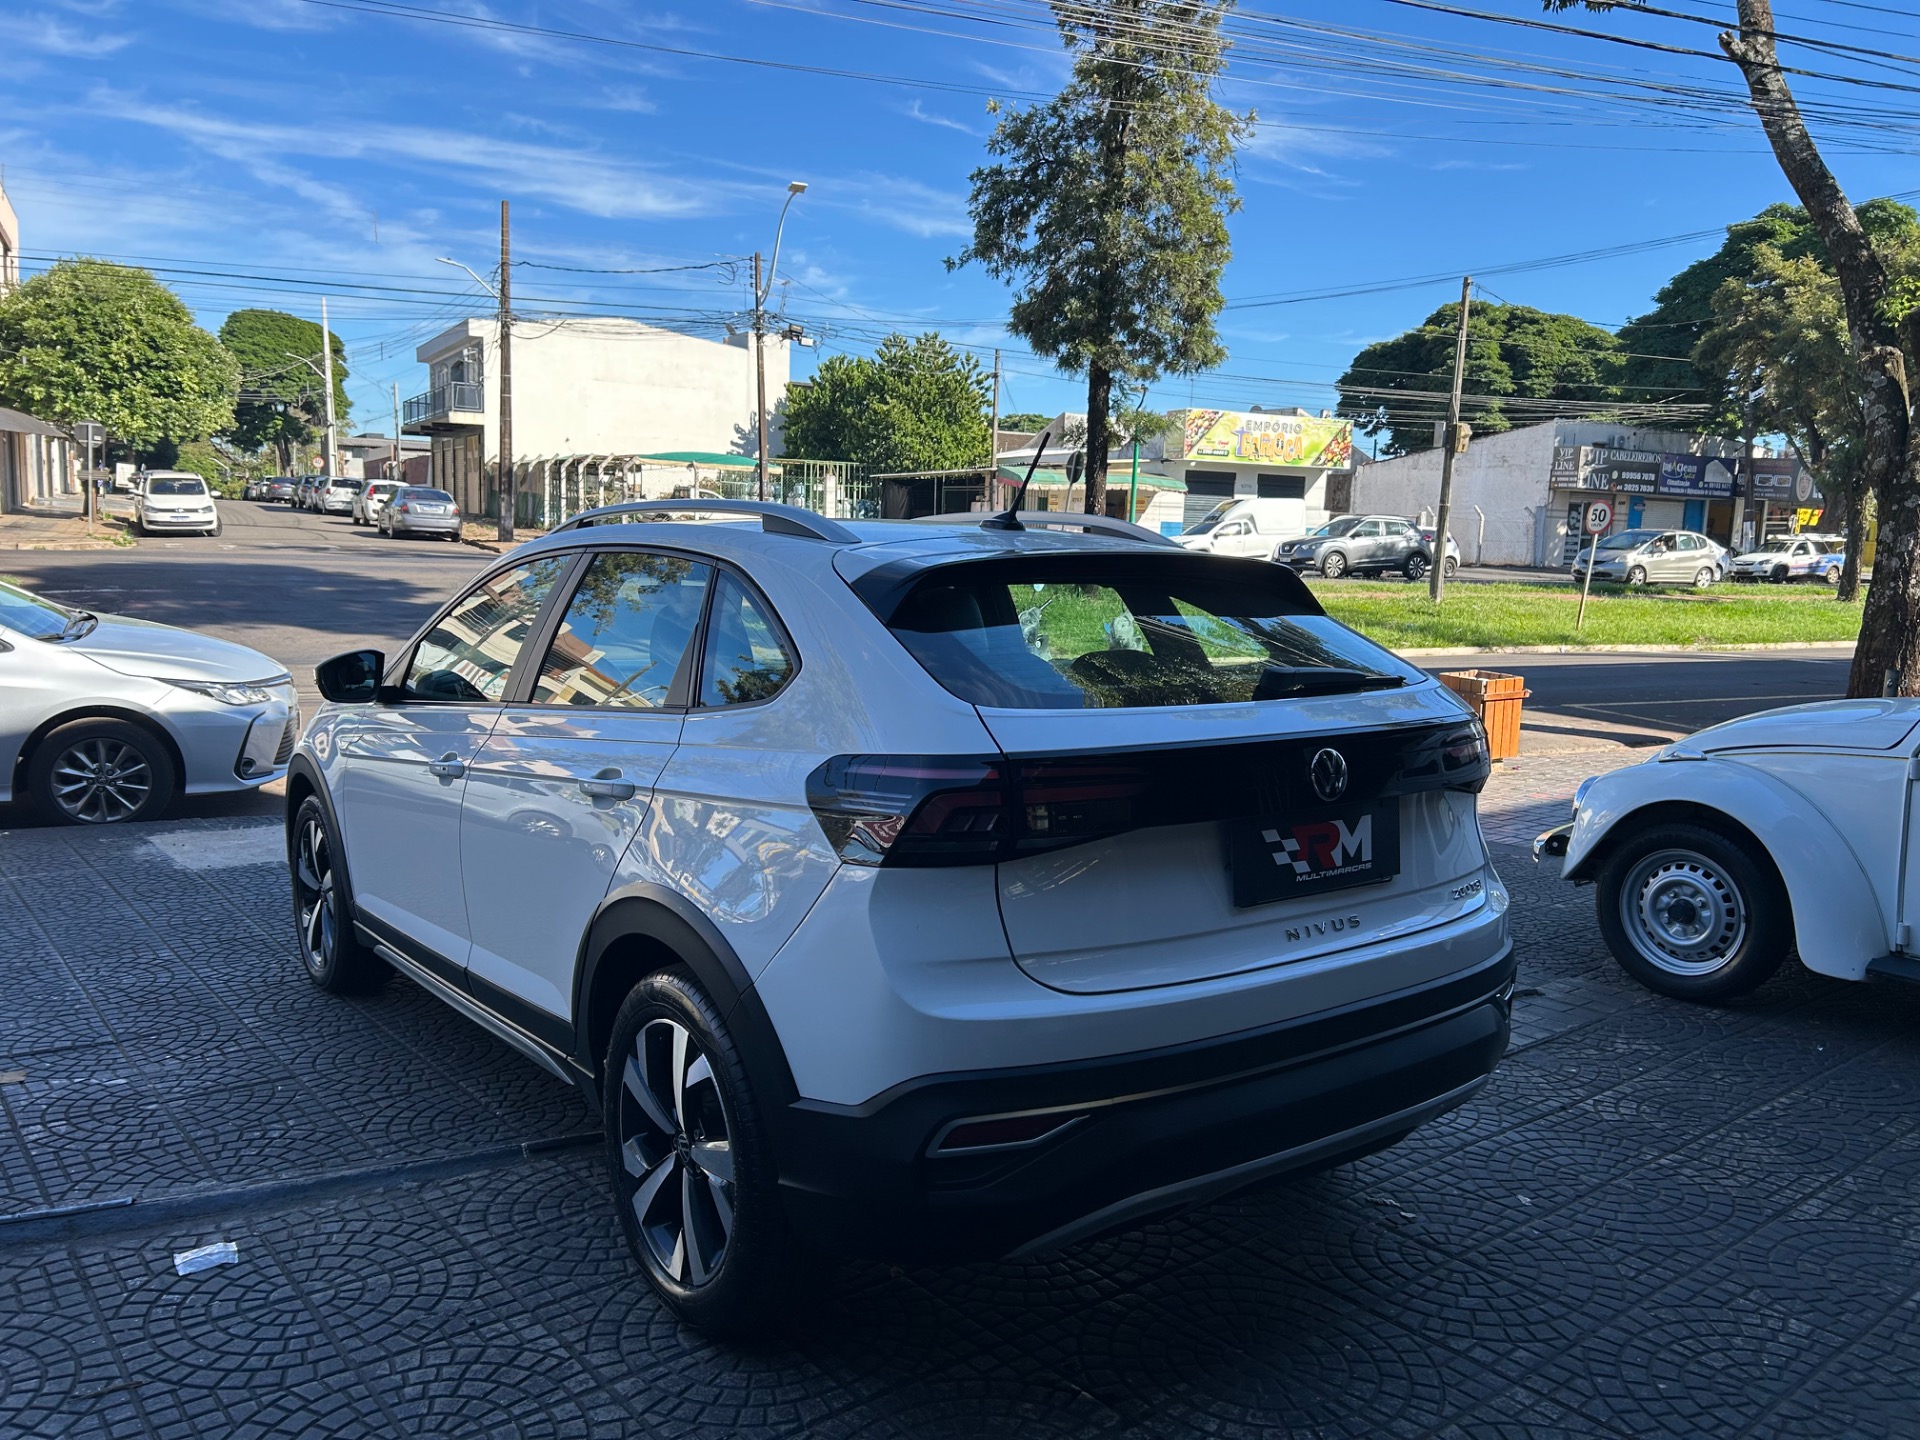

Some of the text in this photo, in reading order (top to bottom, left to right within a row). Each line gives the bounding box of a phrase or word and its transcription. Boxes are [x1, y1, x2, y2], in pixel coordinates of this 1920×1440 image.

[1246, 420, 1302, 434] EMPÓRIO
[1242, 433, 1304, 462] CARIOCA
[1559, 448, 1574, 457] VIP
[1585, 448, 1608, 465] VIP
[1554, 461, 1575, 470] LINE
[1677, 463, 1697, 473] Clean
[1578, 472, 1609, 490] LINE
[1591, 508, 1607, 522] 50
[1291, 814, 1372, 869] RM
[1296, 862, 1373, 882] MULTIMARCAS
[1286, 914, 1361, 942] NIVUS
